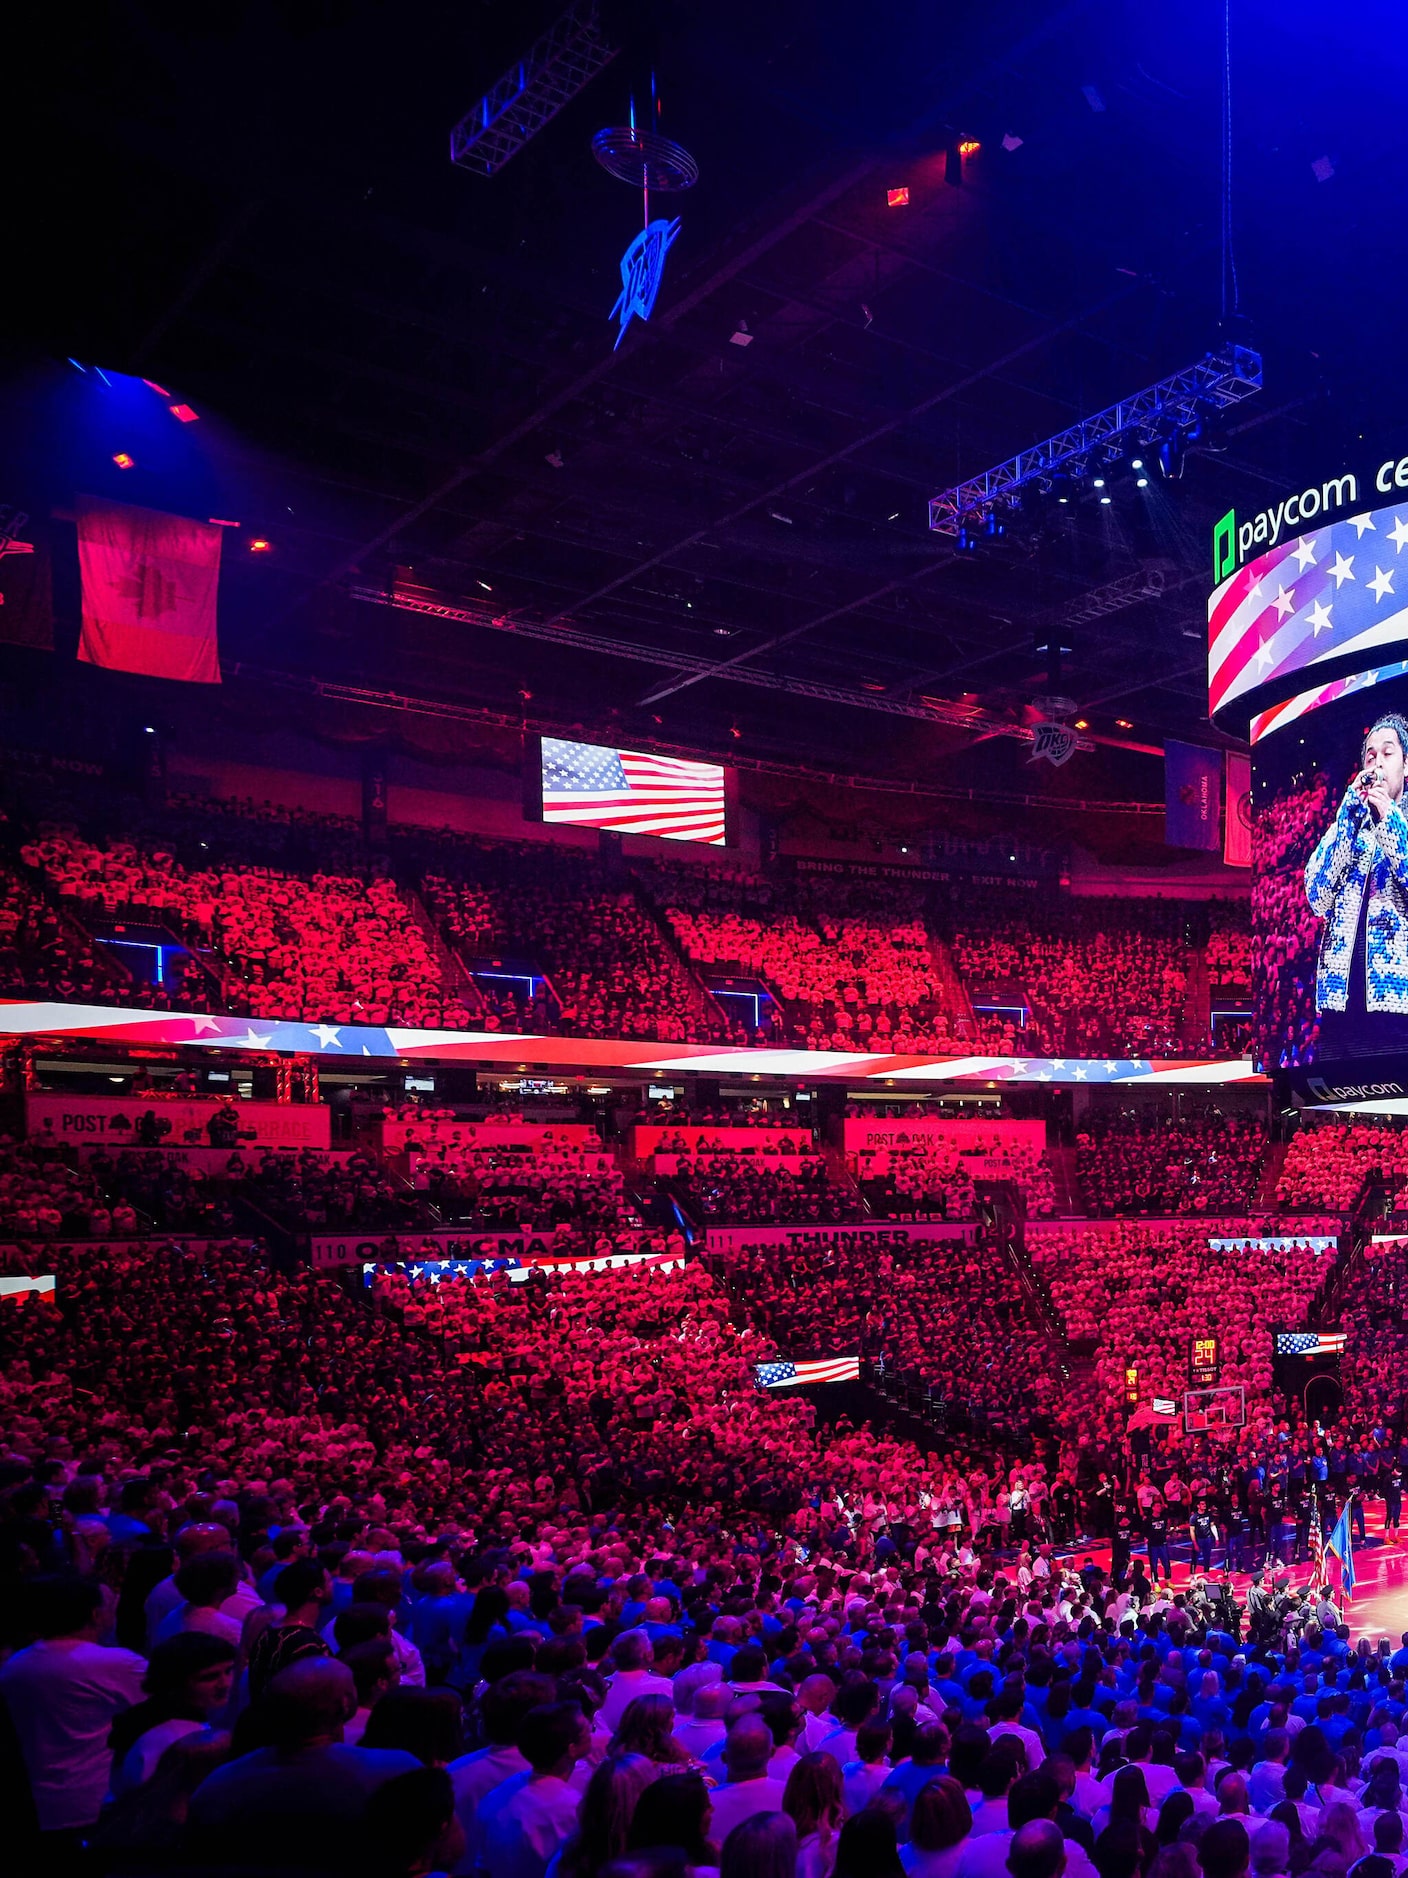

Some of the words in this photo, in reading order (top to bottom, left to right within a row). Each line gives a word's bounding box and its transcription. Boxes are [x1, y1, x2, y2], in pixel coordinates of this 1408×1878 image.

[1238, 474, 1358, 563] paycom
[1200, 775, 1209, 821] OKLAHOMA
[796, 861, 845, 874] BRING
[848, 865, 878, 876] THE
[883, 868, 951, 882] THUNDER
[1332, 1081, 1405, 1099] paycom
[62, 1114, 107, 1133] POST
[786, 1231, 909, 1249] THUNDER
[317, 1245, 346, 1260] 110
[1195, 1350, 1214, 1365] 24
